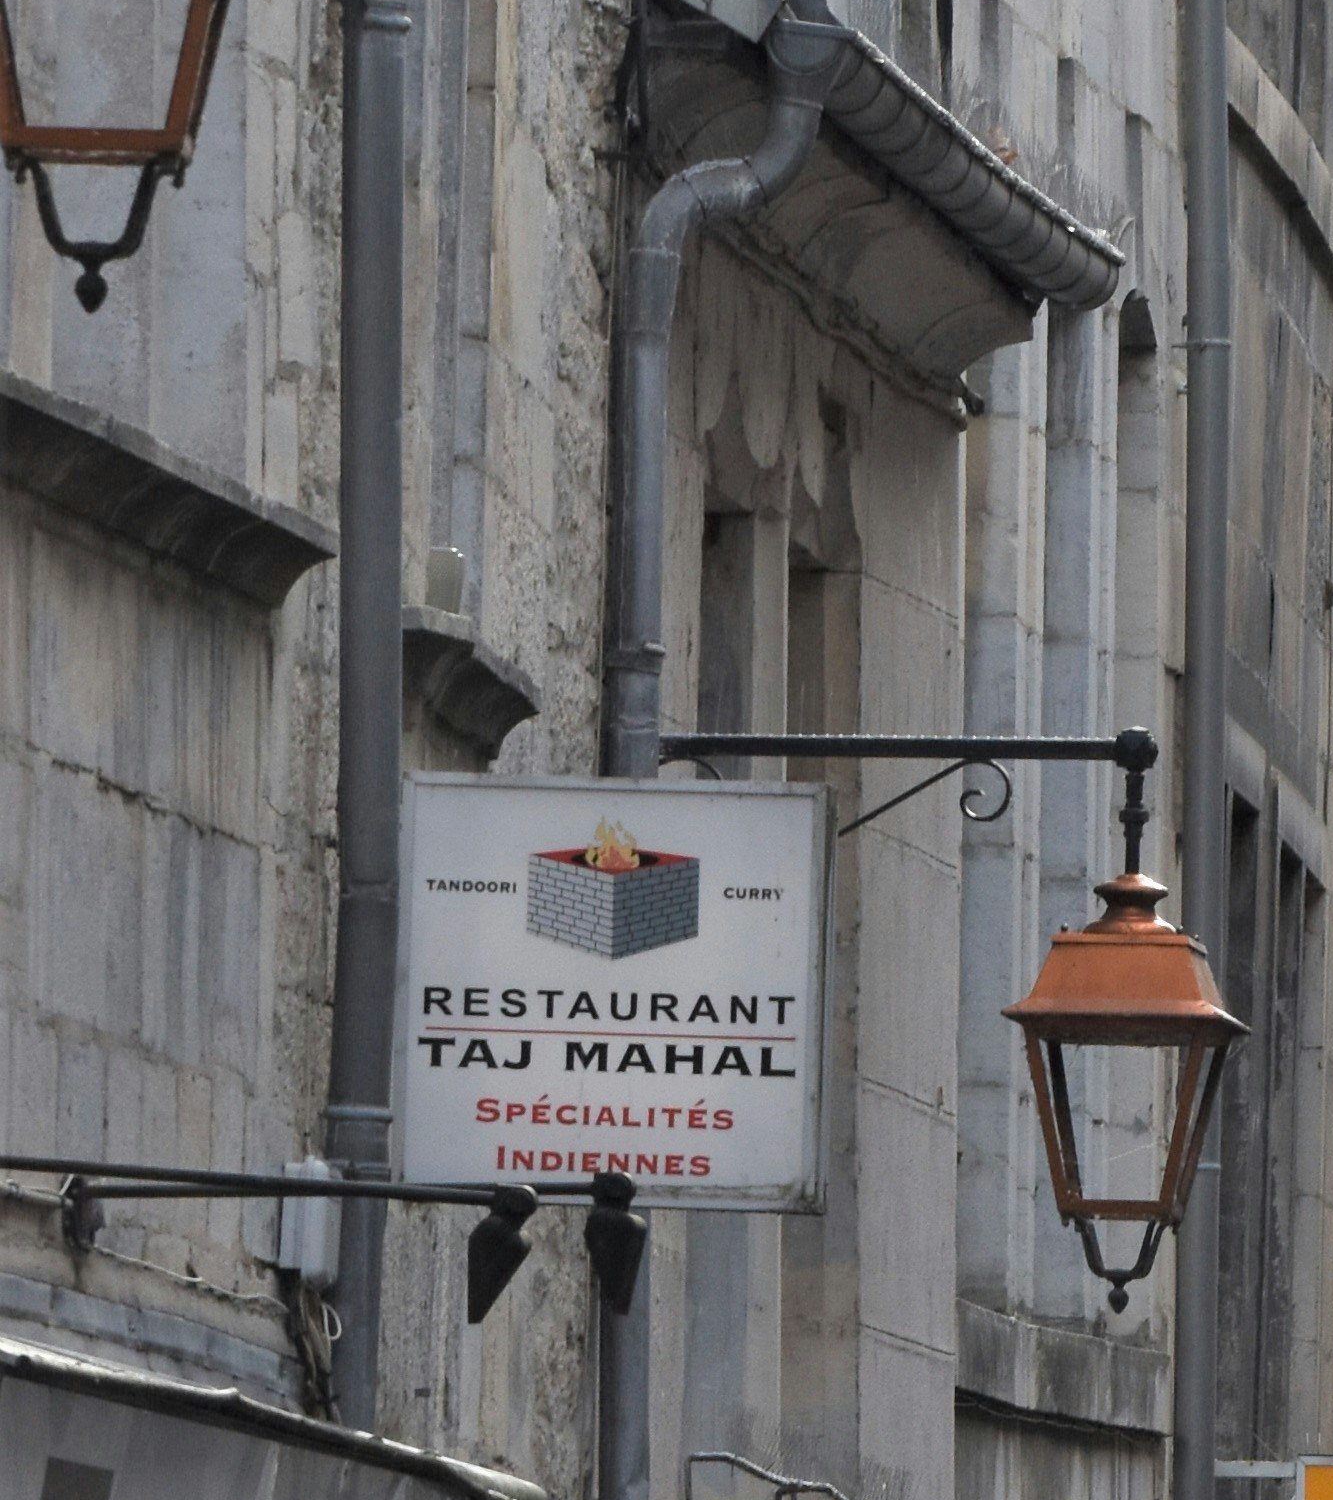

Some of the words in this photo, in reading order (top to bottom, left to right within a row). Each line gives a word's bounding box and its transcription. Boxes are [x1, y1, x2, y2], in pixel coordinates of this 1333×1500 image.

[426, 879, 517, 895] TANDOORI
[723, 886, 783, 902] CURRY
[423, 986, 796, 1026] RESTAURANT
[418, 1036, 533, 1071] TAJ
[564, 1041, 797, 1078] MAHAL
